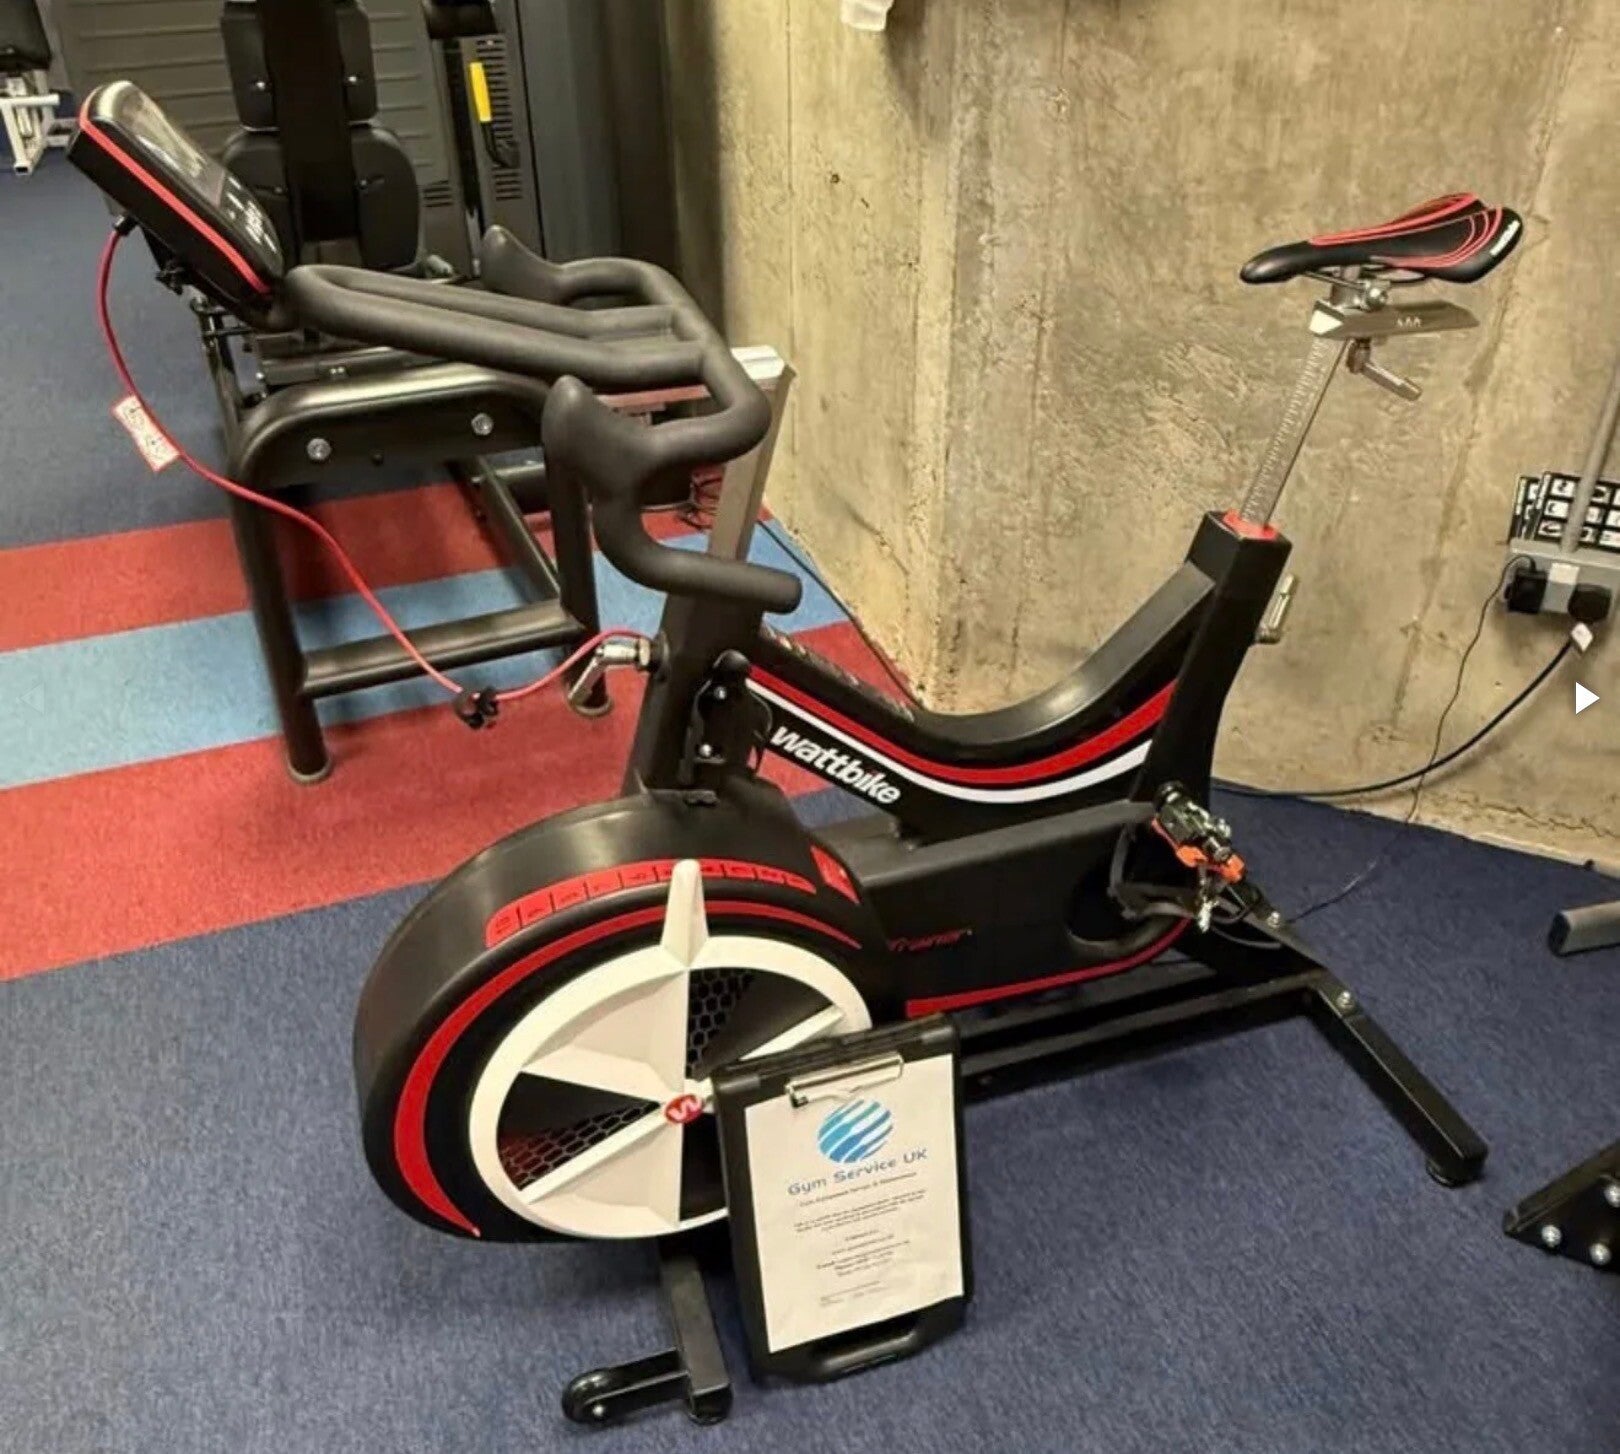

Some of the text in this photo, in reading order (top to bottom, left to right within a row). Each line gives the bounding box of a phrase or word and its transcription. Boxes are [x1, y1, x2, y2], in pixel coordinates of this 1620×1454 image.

[770, 726, 900, 804] wattbike
[787, 1178, 827, 1196] Gym
[833, 1159, 897, 1183] Service
[902, 1147, 928, 1164] UK
